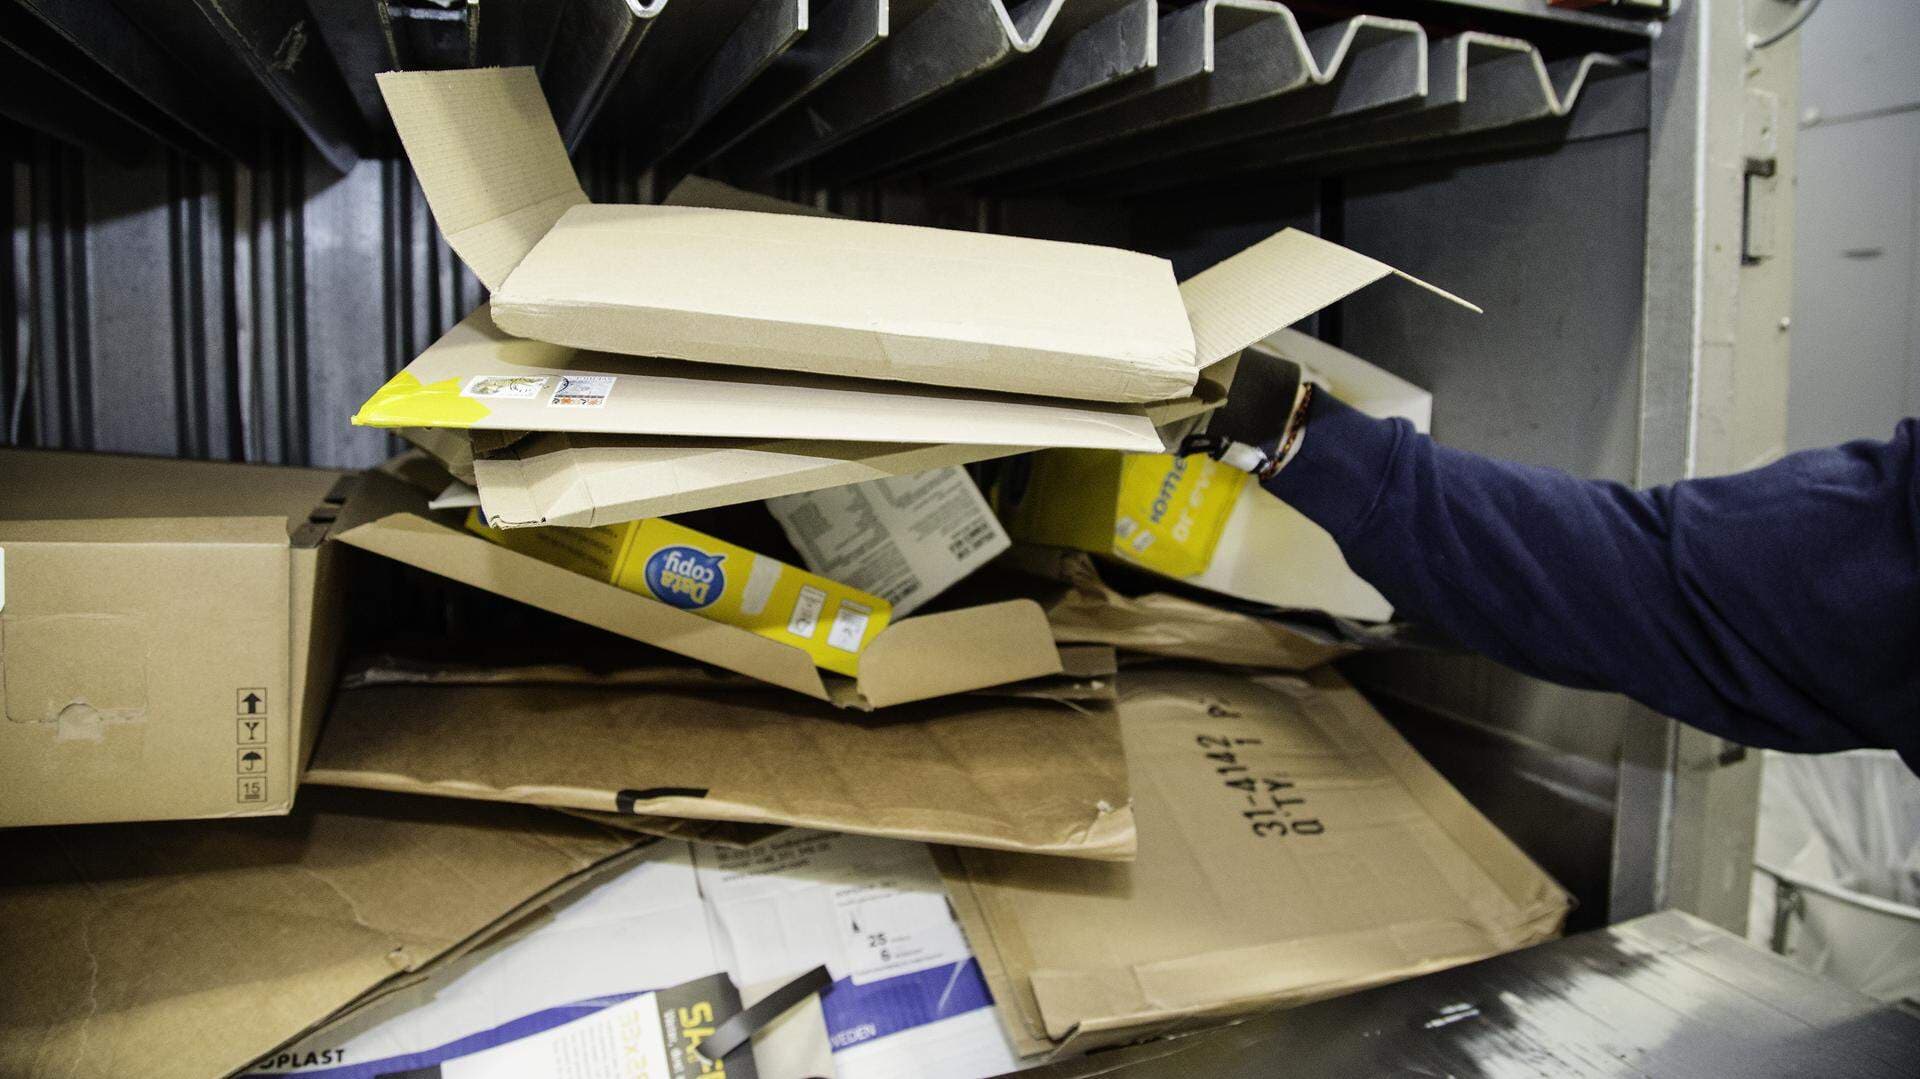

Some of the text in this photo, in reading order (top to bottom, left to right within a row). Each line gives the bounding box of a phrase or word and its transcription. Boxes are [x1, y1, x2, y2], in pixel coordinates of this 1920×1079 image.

[663, 550, 715, 584] copy
[660, 568, 711, 605] Data
[243, 782, 261, 794] 15
[1196, 735, 1288, 838] 31-4142
[868, 932, 888, 949] 25
[880, 947, 891, 963] 6
